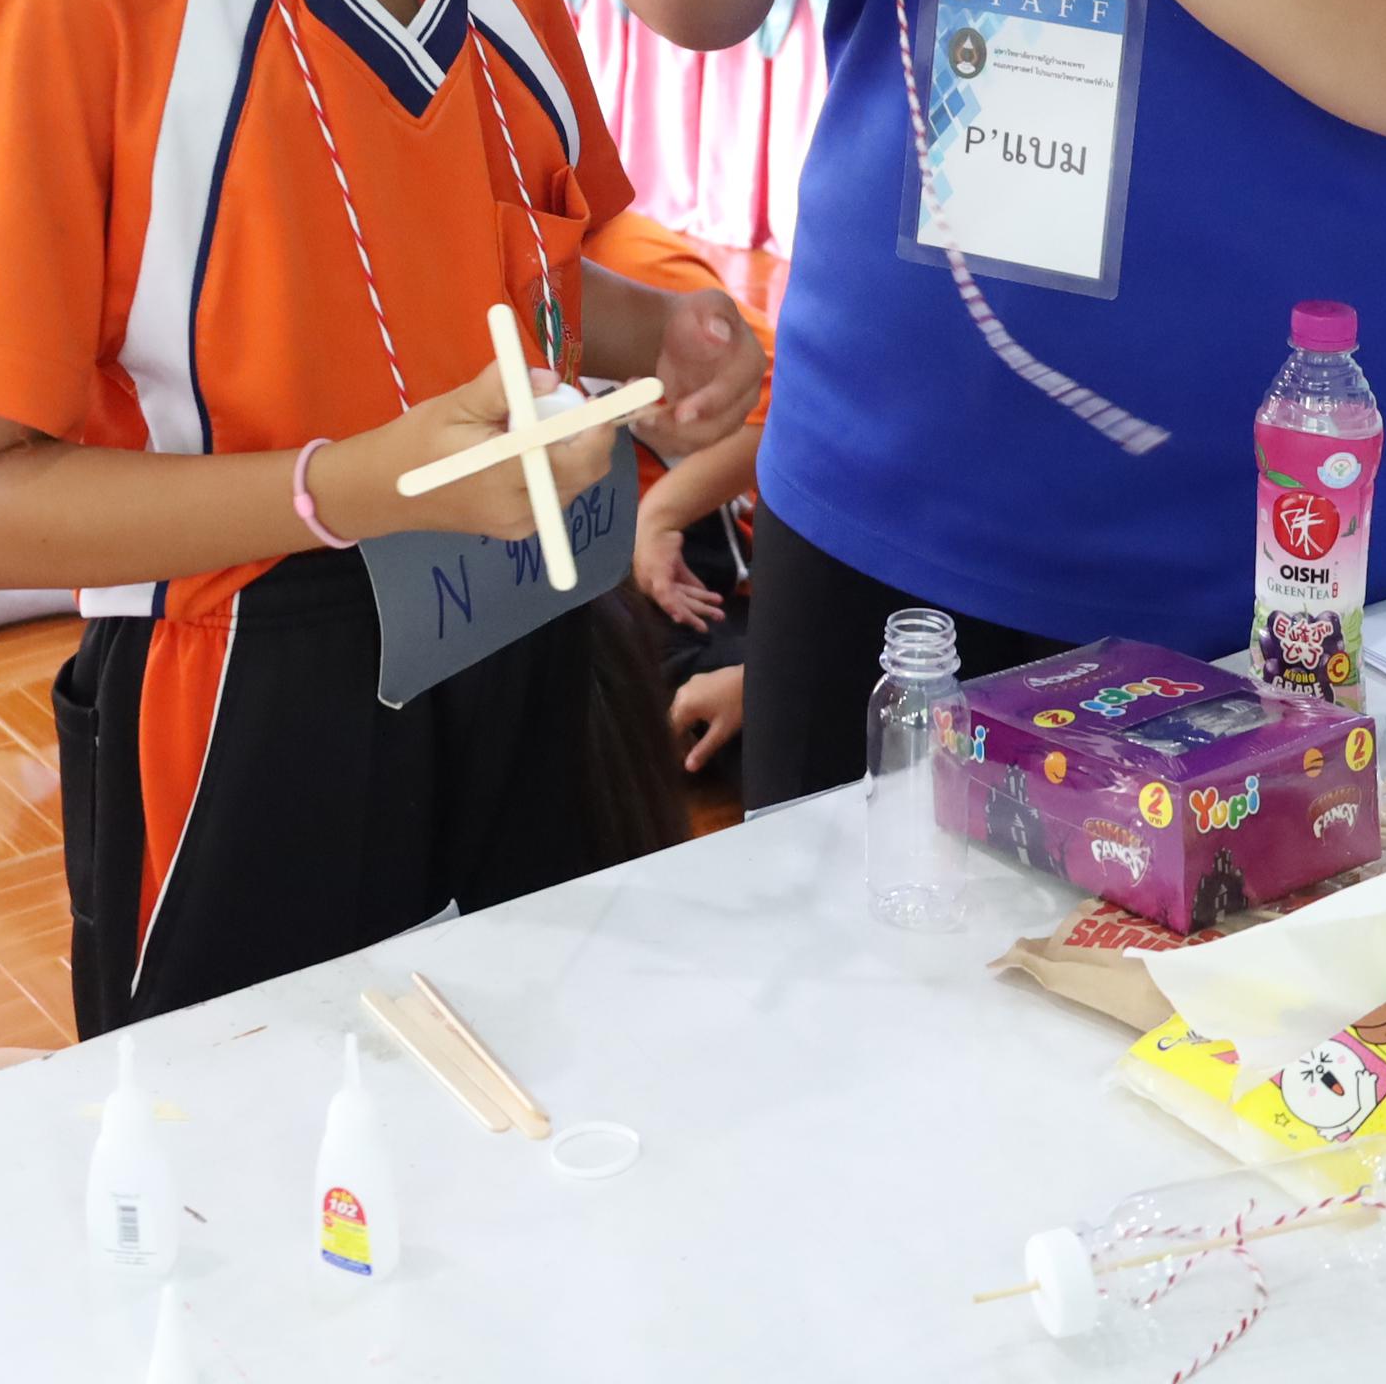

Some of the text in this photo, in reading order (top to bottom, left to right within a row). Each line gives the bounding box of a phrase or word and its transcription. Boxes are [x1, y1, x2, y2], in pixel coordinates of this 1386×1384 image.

[1280, 564, 1330, 584] OISHI
[1273, 676, 1325, 699] GRAPE
[1283, 669, 1316, 684] KYOHO
[1079, 676, 1205, 718] Yupi
[933, 706, 987, 766] Yupi
[1353, 730, 1366, 760] 2
[1148, 787, 1165, 816] 2
[1189, 775, 1260, 834] Yupi
[1313, 803, 1359, 839] FANGS
[1091, 838, 1151, 881] FANGS
[328, 1198, 358, 1219] 102
